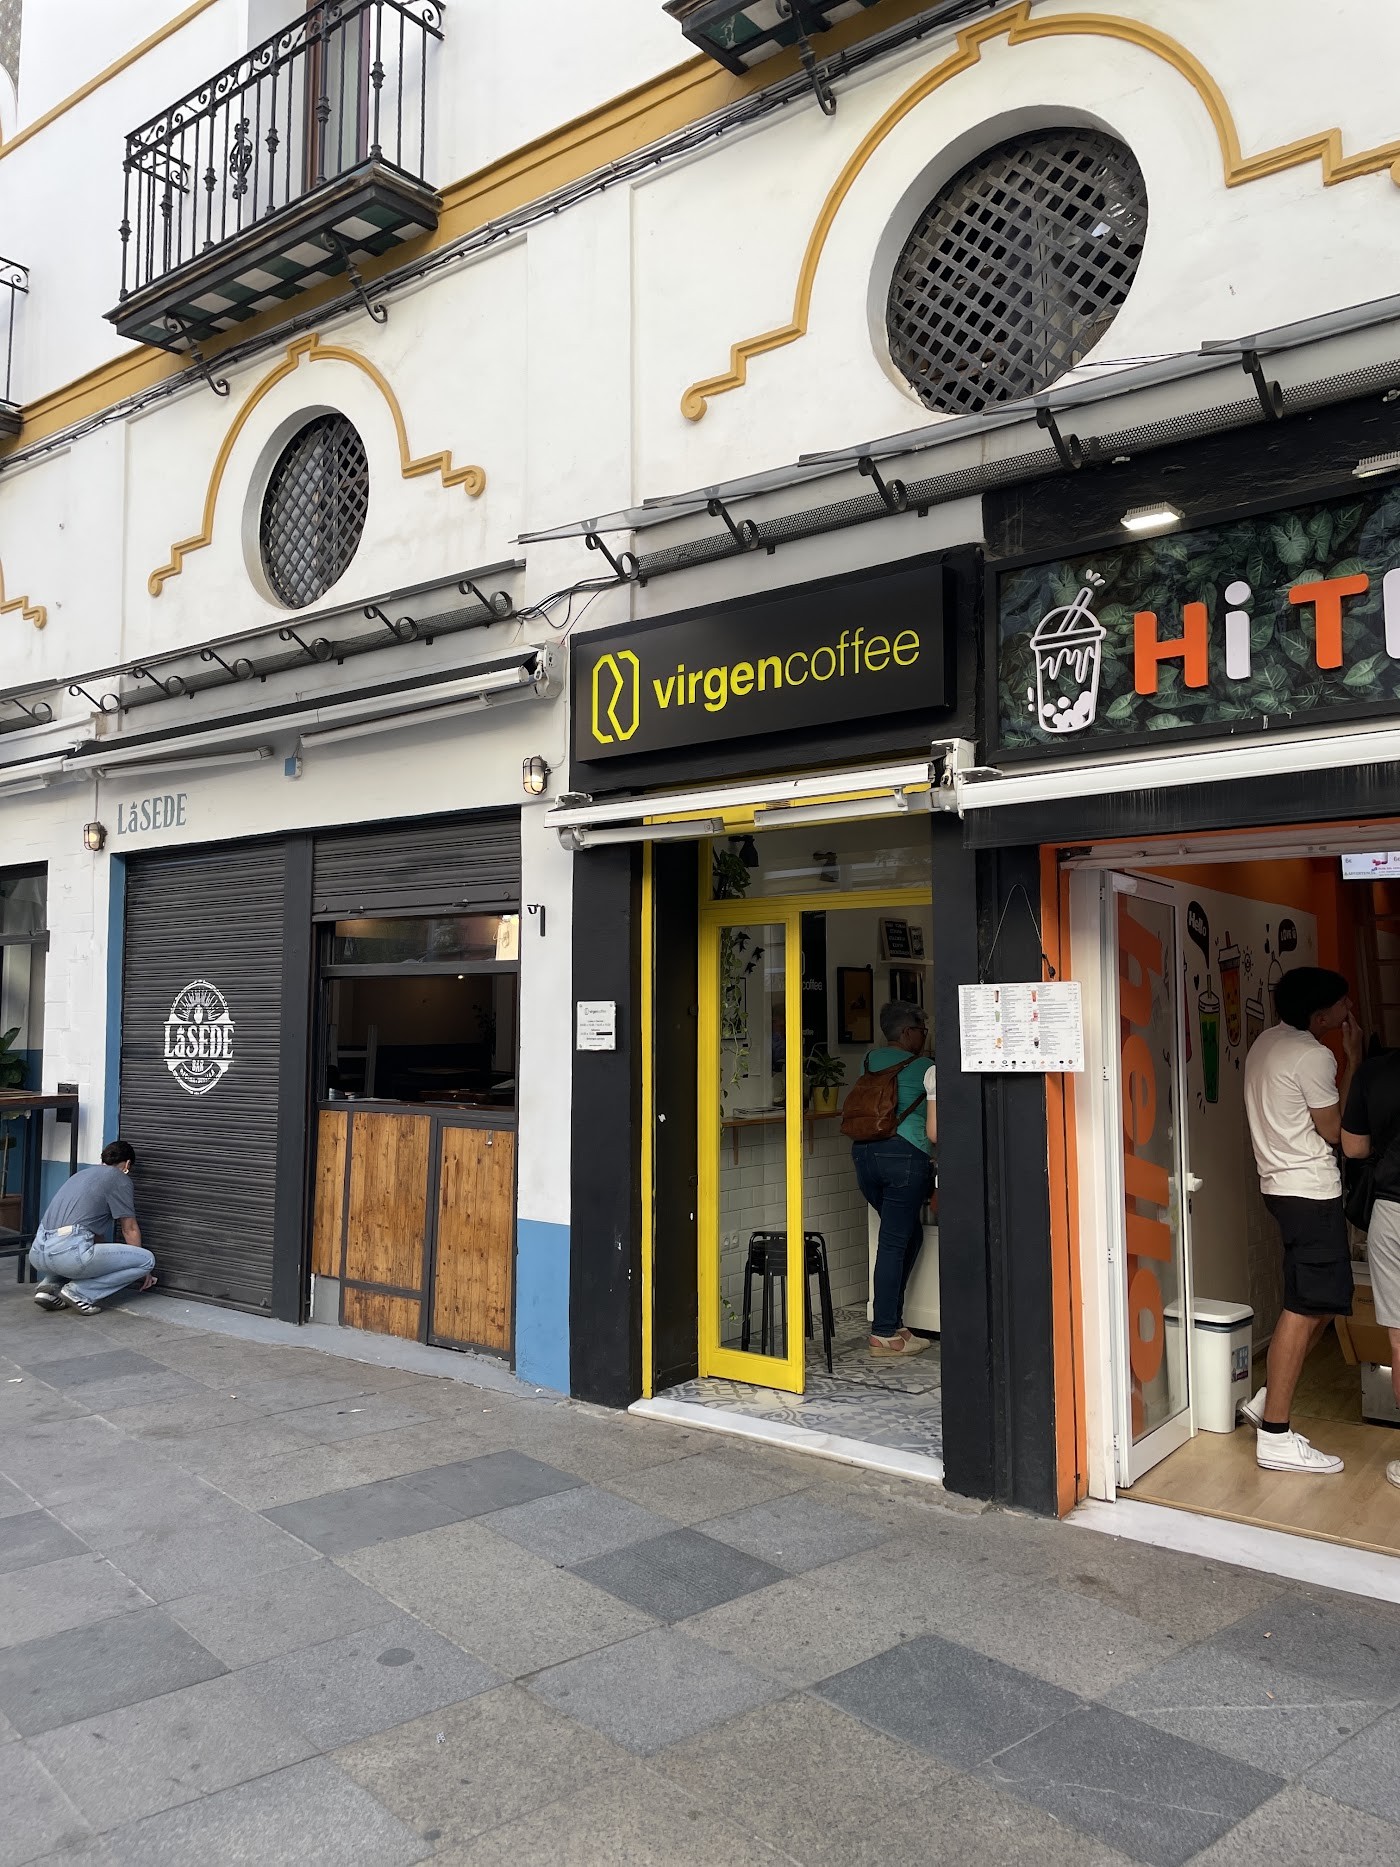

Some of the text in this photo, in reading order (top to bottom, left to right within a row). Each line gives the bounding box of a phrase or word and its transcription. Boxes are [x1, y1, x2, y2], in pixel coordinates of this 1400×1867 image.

[652, 626, 920, 712] virgencoffee
[1133, 567, 1400, 695] Hi T
[1188, 910, 1207, 937] Hello
